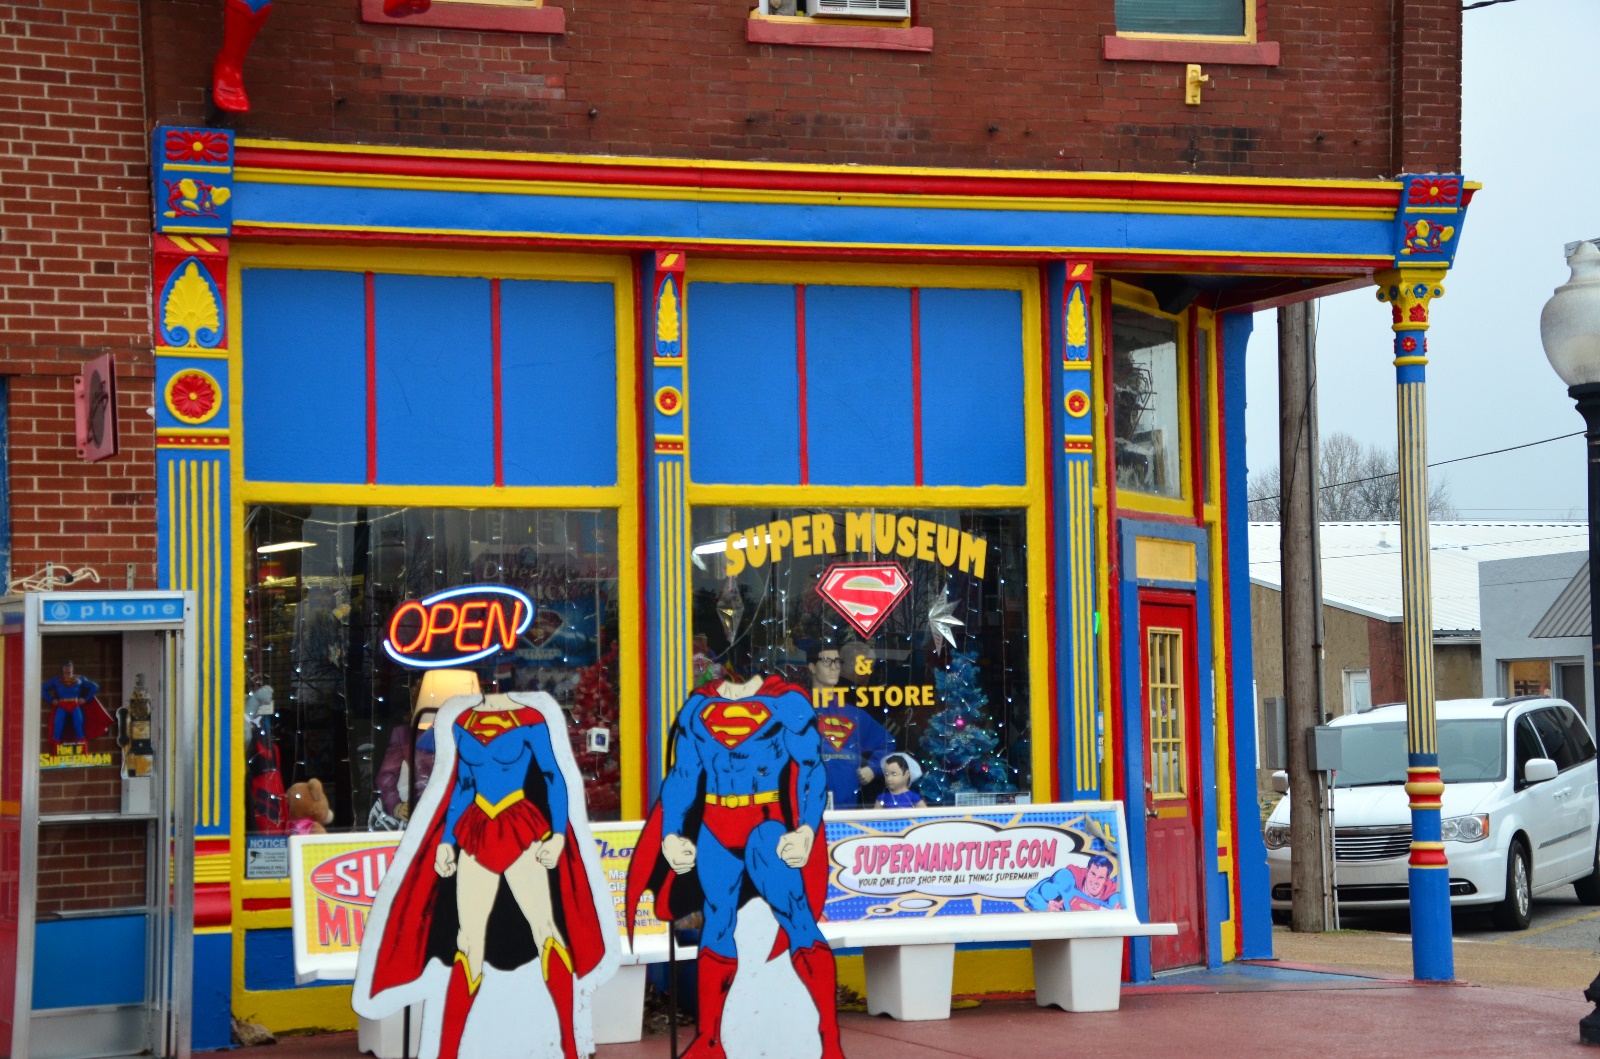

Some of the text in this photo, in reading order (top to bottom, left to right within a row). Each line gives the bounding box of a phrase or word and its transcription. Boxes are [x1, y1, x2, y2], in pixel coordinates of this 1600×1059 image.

[725, 511, 988, 580] SUPER MUSEUM
[80, 602, 176, 619] phone
[389, 601, 523, 653] OPEN
[854, 654, 874, 676] &
[812, 685, 936, 709] IFT STORE
[39, 752, 112, 768] SUPERMAN
[250, 839, 286, 848] NOTICE
[852, 838, 1058, 876] SUPERMANSTUFF.COM
[858, 878, 878, 888] YOUR
[880, 877, 895, 887] ONE
[897, 876, 916, 887] STOP
[917, 875, 937, 886] SHOP
[938, 875, 953, 884] FOR
[953, 874, 966, 885] ALL
[968, 873, 993, 884] THINGS
